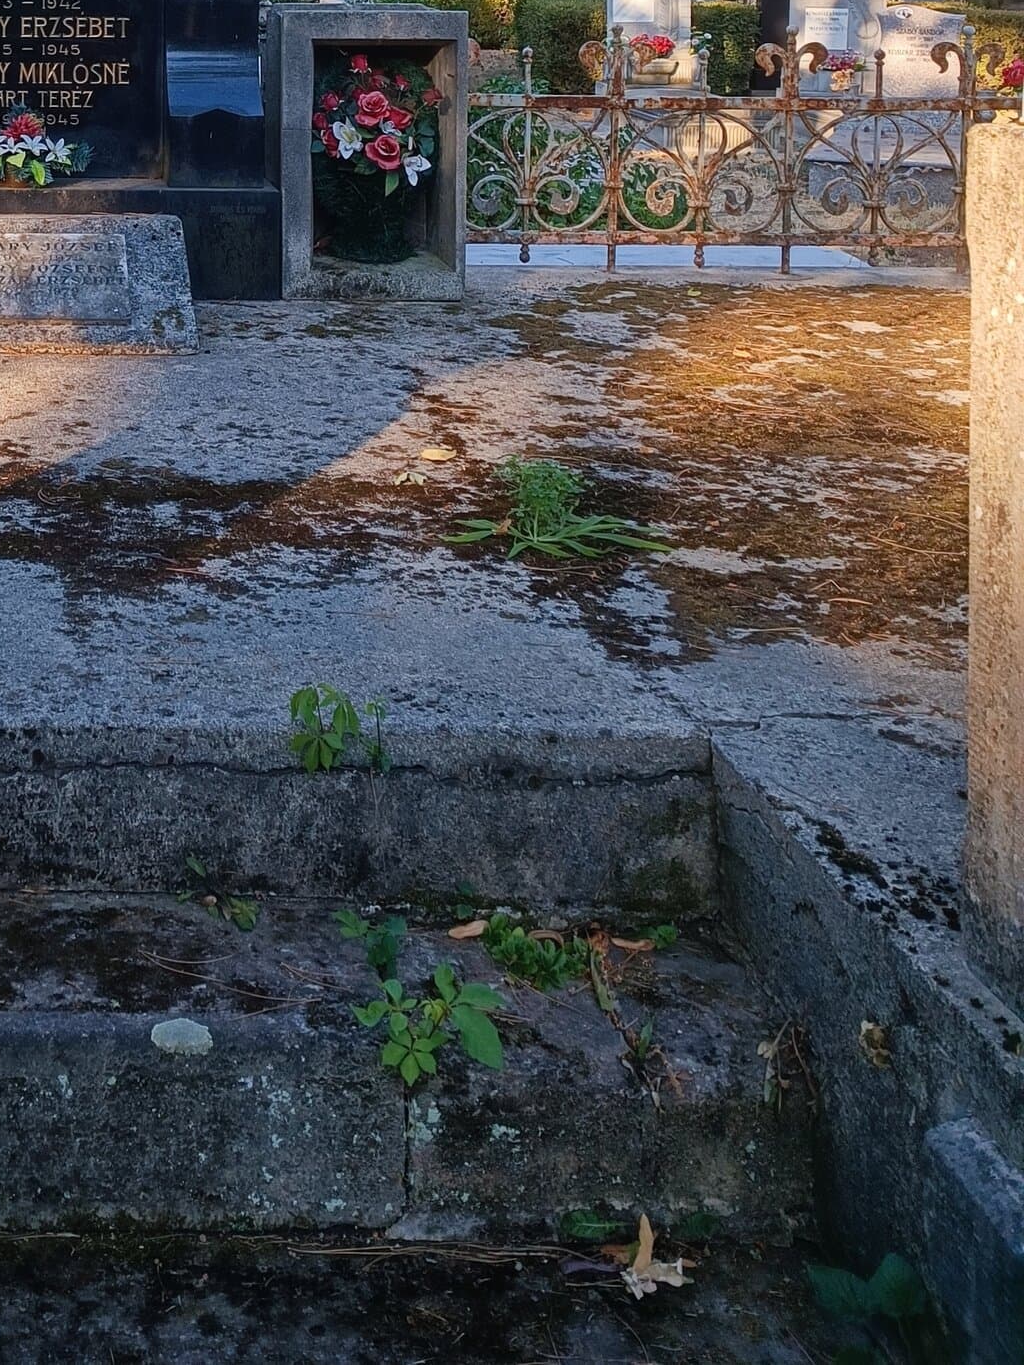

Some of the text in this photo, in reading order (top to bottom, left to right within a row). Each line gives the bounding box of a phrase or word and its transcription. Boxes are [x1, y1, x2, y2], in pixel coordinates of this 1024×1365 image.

[21, 12, 130, 38] ERZSÉBET
[42, 43, 81, 55] 1945
[18, 58, 130, 84] MIKLÓSNÉ
[38, 87, 93, 108] TERÉZ
[41, 113, 80, 125] 945
